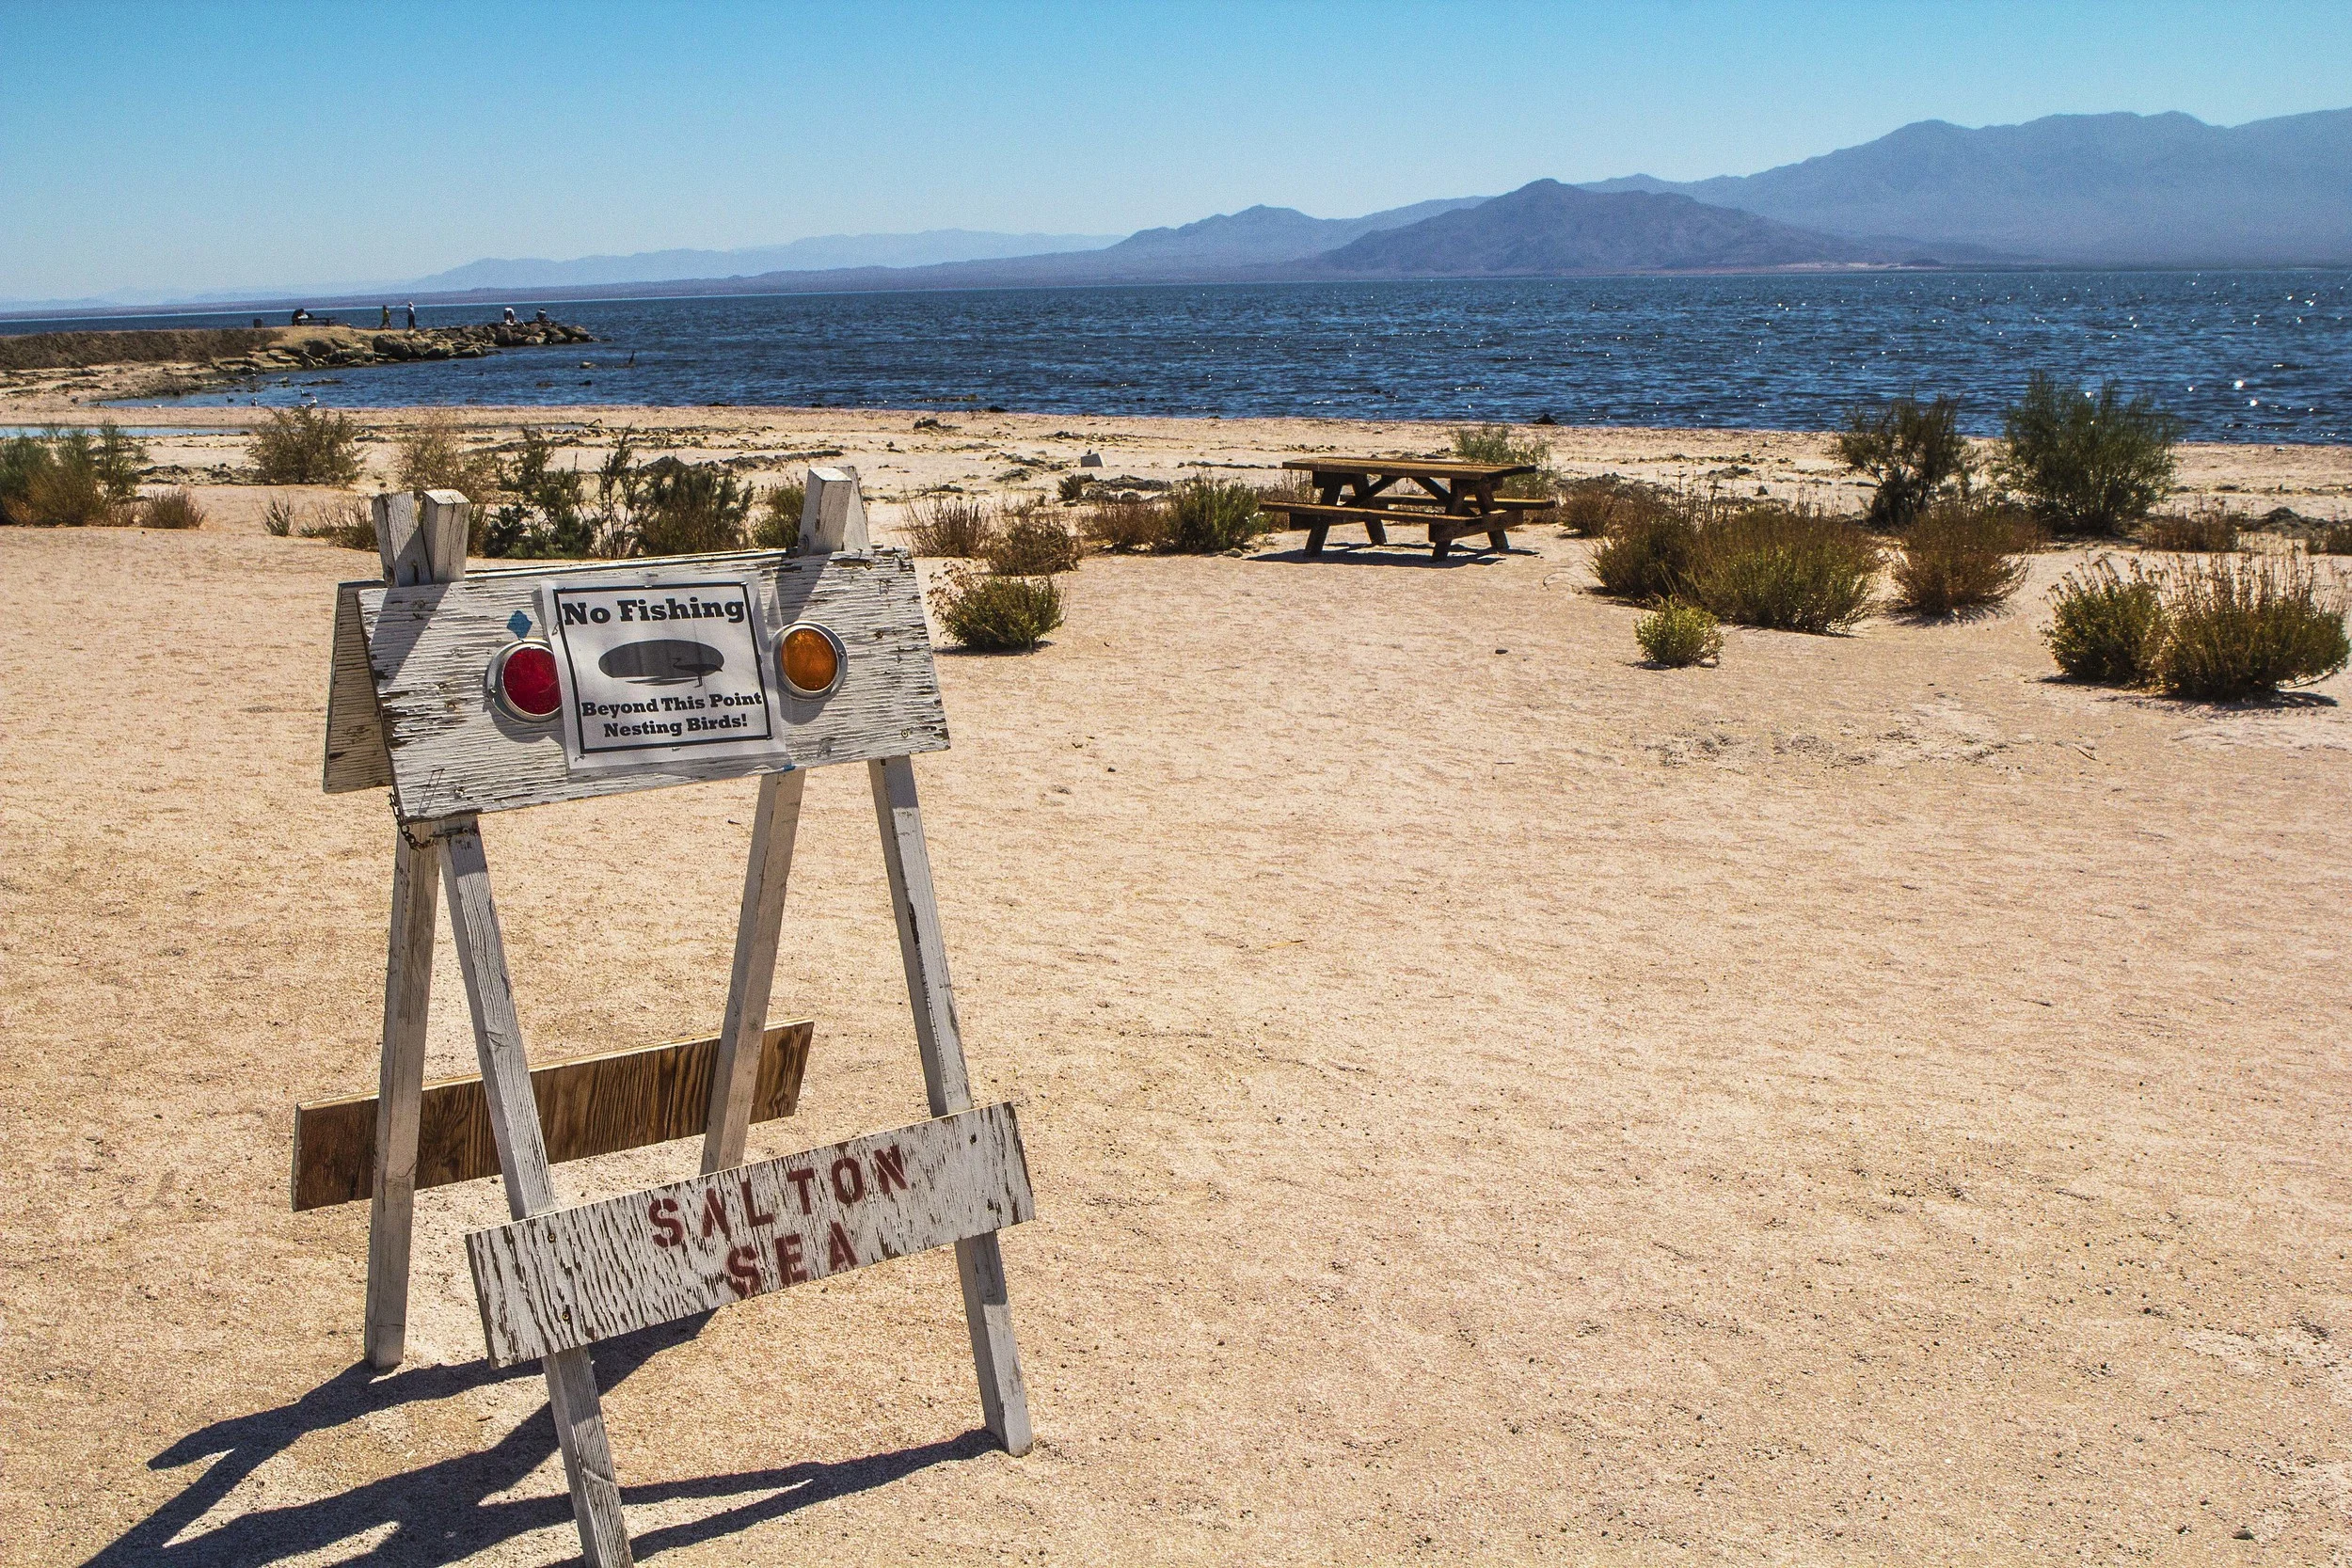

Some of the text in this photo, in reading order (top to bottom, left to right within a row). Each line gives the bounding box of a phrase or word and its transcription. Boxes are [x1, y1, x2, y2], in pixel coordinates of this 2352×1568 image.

[563, 596, 745, 626] No Fishing
[581, 691, 763, 719] Beyond This Point
[604, 713, 748, 737] Nesting Birds!
[648, 1145, 910, 1249] SALTON
[724, 1221, 859, 1298] SEA
